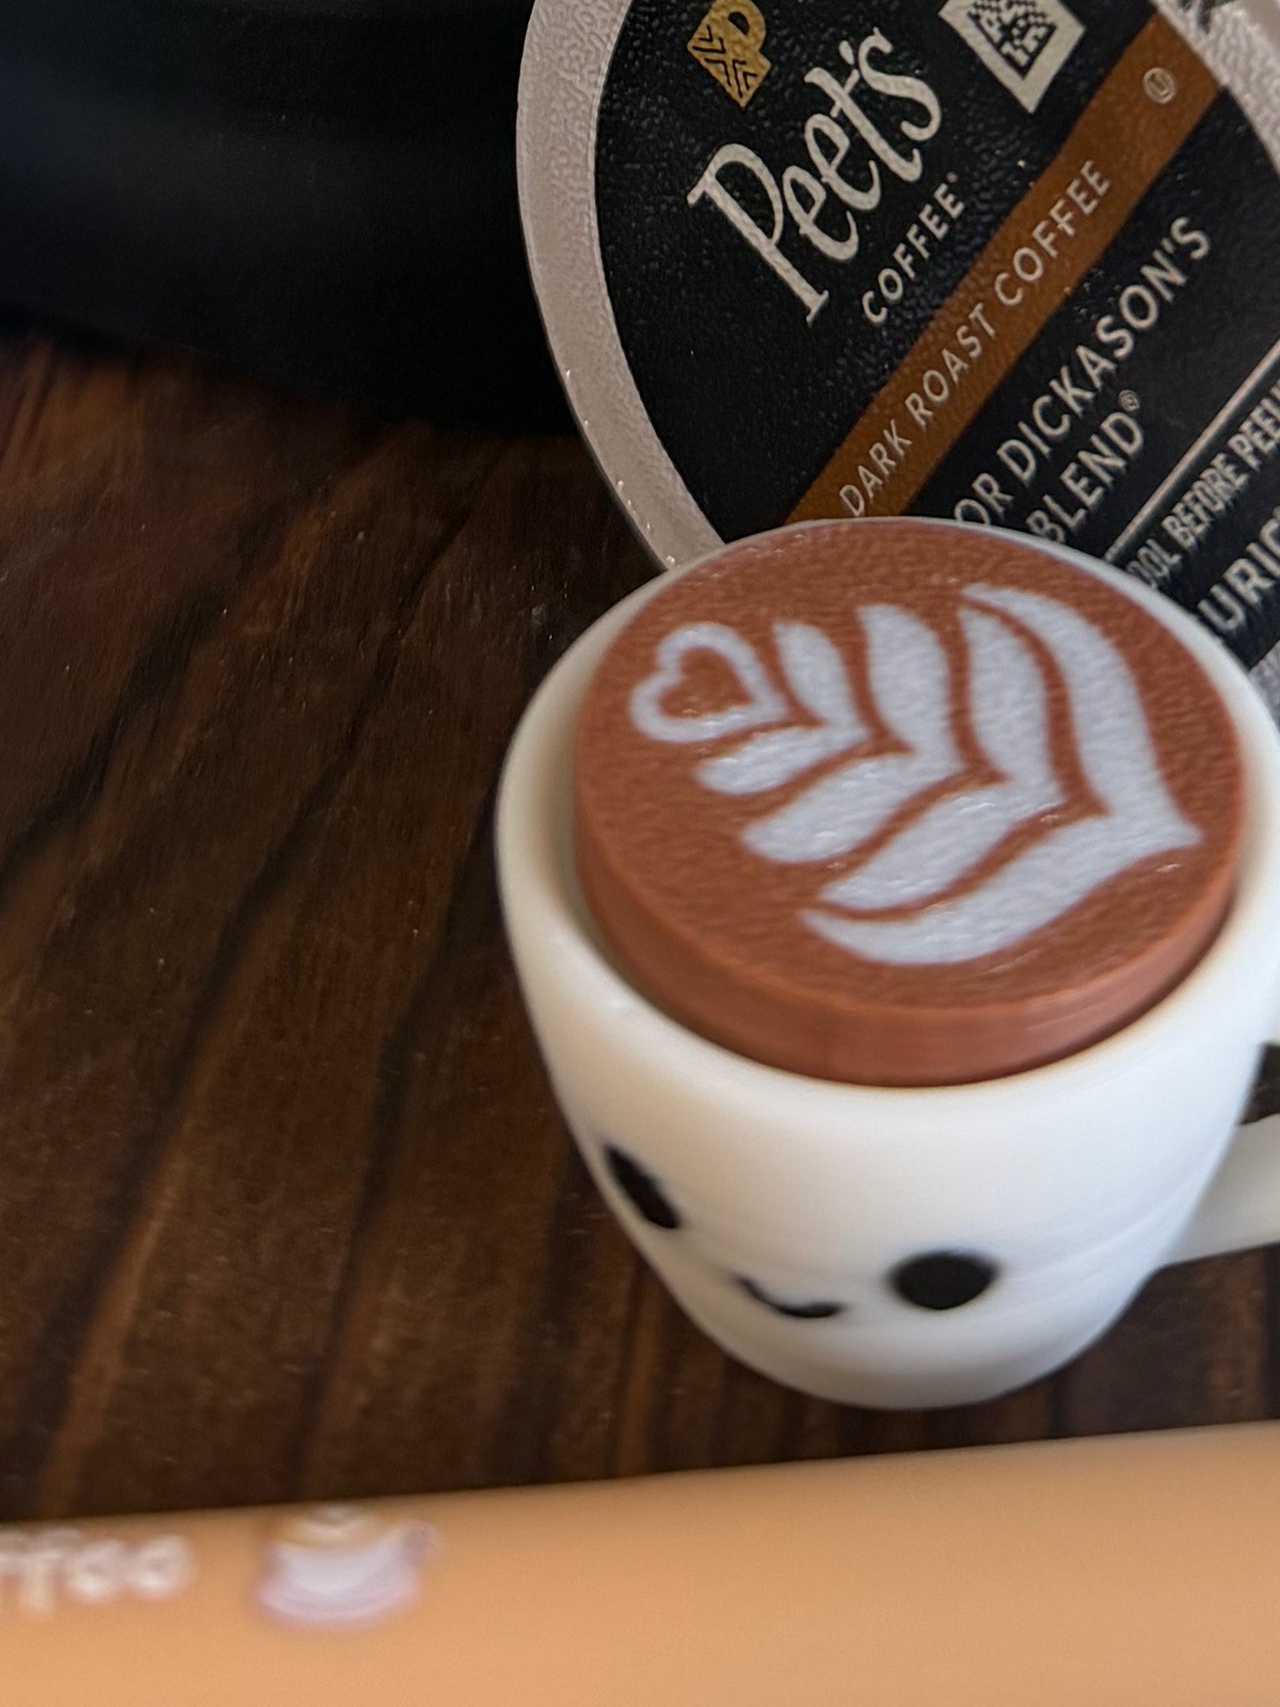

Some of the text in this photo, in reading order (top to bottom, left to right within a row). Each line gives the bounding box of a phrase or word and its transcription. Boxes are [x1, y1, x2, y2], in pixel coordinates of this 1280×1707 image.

[687, 27, 941, 326] Peet's
[839, 160, 1111, 517] DARK ROAST COFFEE
[997, 217, 1210, 484] DICKASON'S
[1161, 453, 1250, 552] BEFORE
